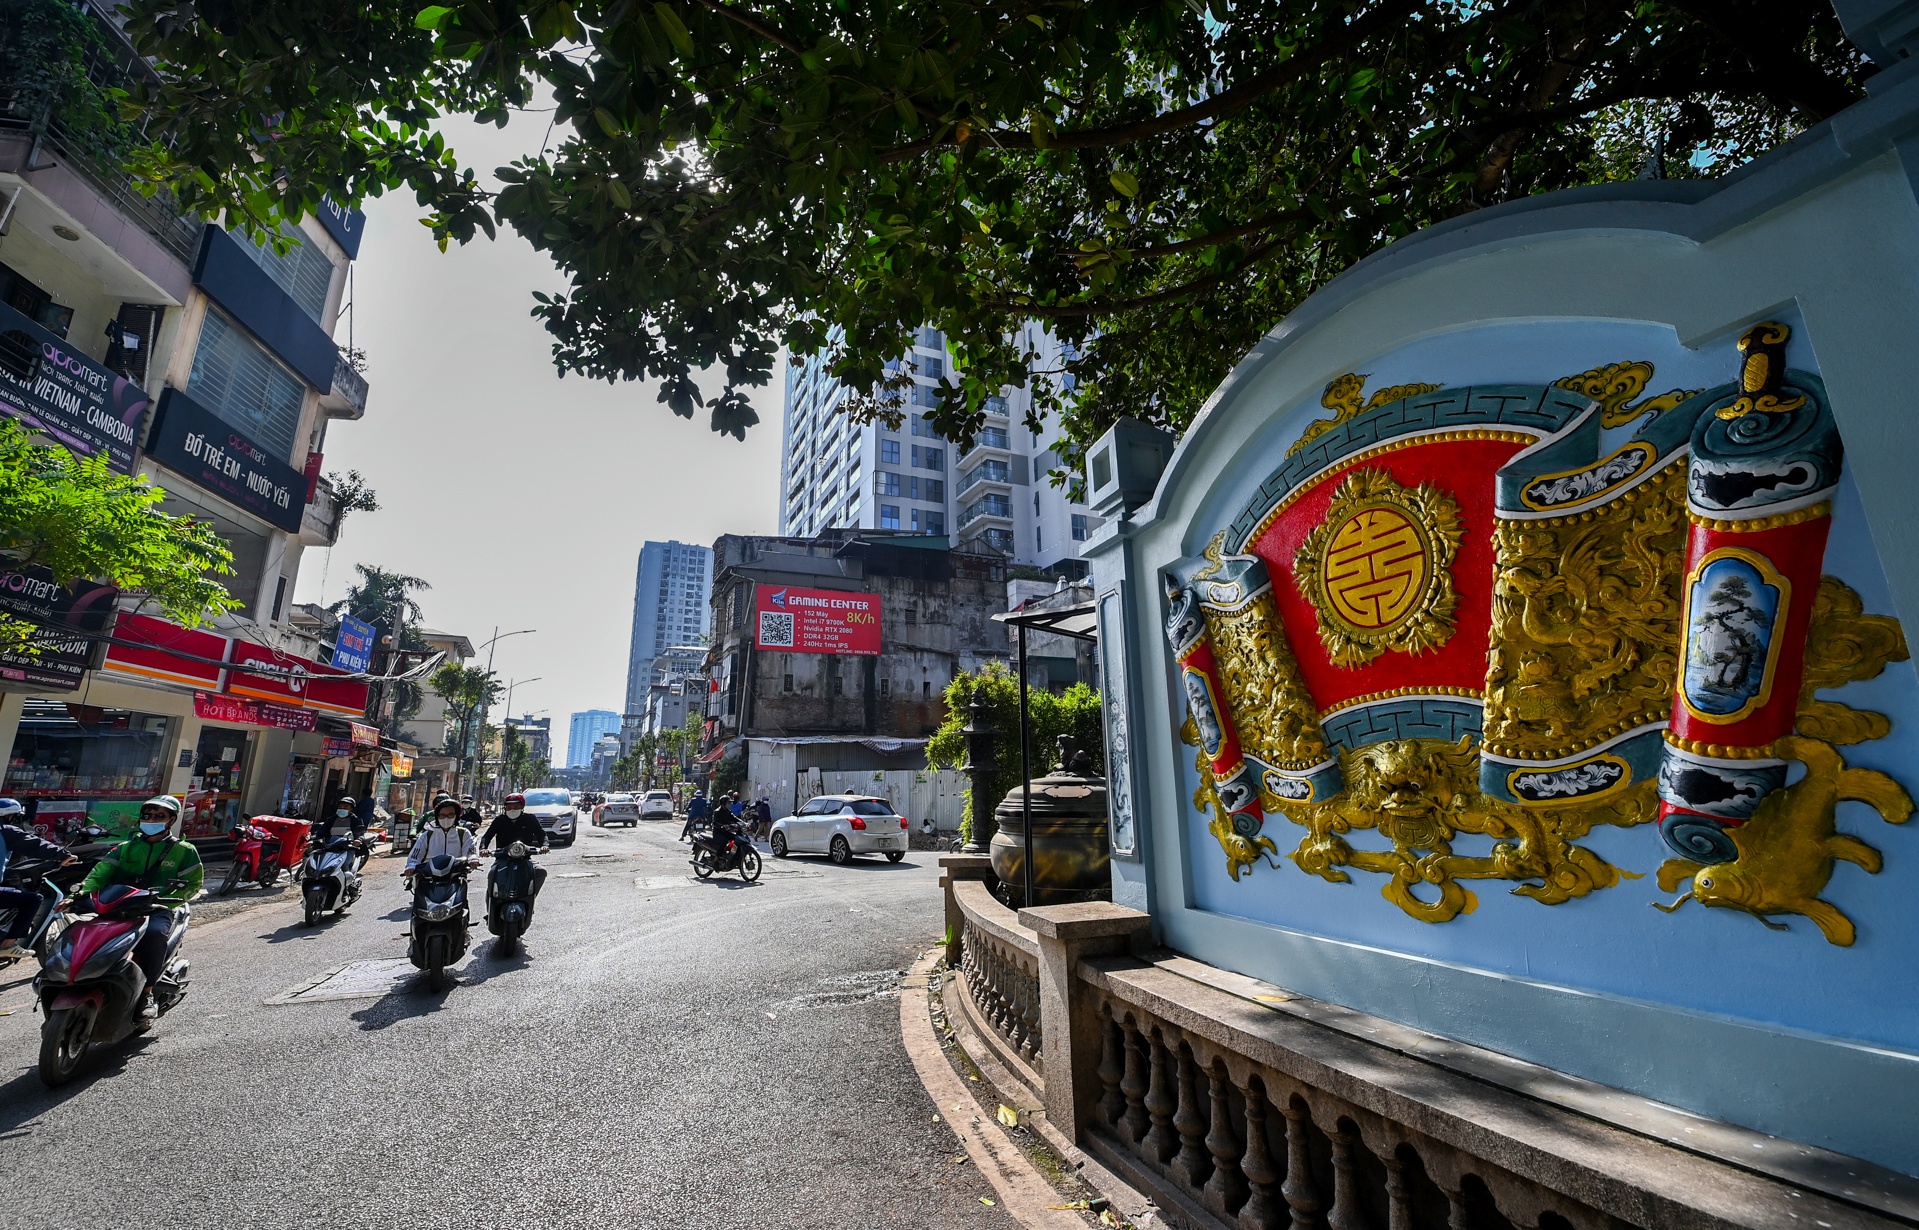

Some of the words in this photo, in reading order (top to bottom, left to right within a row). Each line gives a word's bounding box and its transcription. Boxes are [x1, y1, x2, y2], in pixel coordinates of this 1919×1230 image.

[42, 342, 108, 392] apromart
[34, 375, 82, 417] VIETNAM
[86, 406, 135, 447] CAMBODIA
[228, 434, 266, 466] apromart
[184, 432, 205, 457] ĐỒ
[203, 443, 225, 471] TRẺ
[223, 456, 241, 480] EM
[246, 470, 273, 499] NƯỚC
[273, 485, 291, 510] YẾN
[0, 571, 61, 602] romart
[789, 596, 829, 608] GAMING
[830, 599, 869, 611] CENTER
[846, 611, 875, 625] 8K/h
[27, 674, 76, 686] www.apromart.com
[203, 704, 226, 717] HOT
[227, 707, 258, 722] BRANDS
